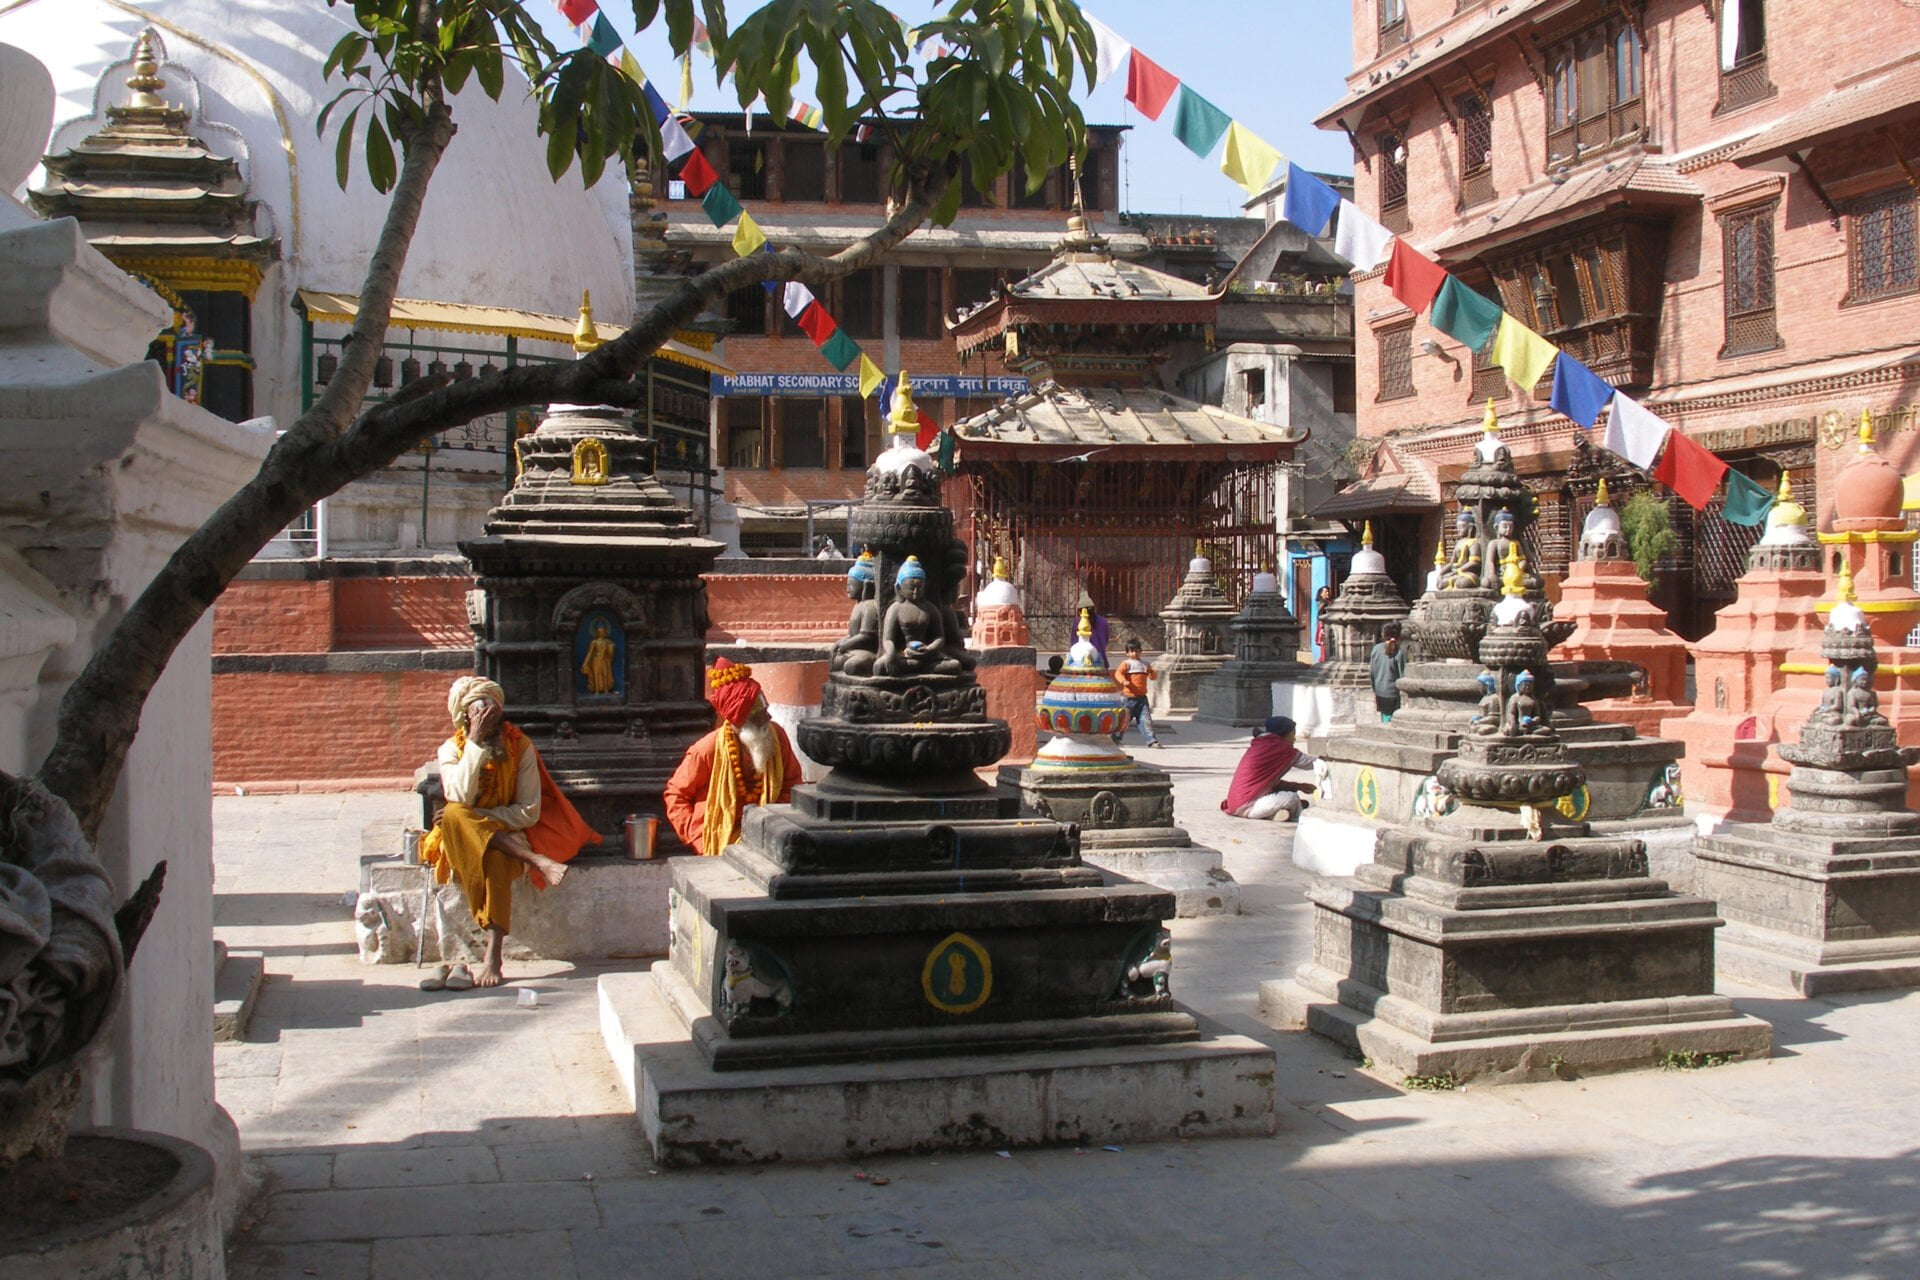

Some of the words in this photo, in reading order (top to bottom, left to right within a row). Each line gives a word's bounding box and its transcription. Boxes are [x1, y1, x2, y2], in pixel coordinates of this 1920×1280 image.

[723, 375, 775, 388] PRABHAT
[778, 375, 842, 388] SECONDARY
[844, 376, 884, 388] SCL
[1754, 419, 1811, 446] BIHAR
